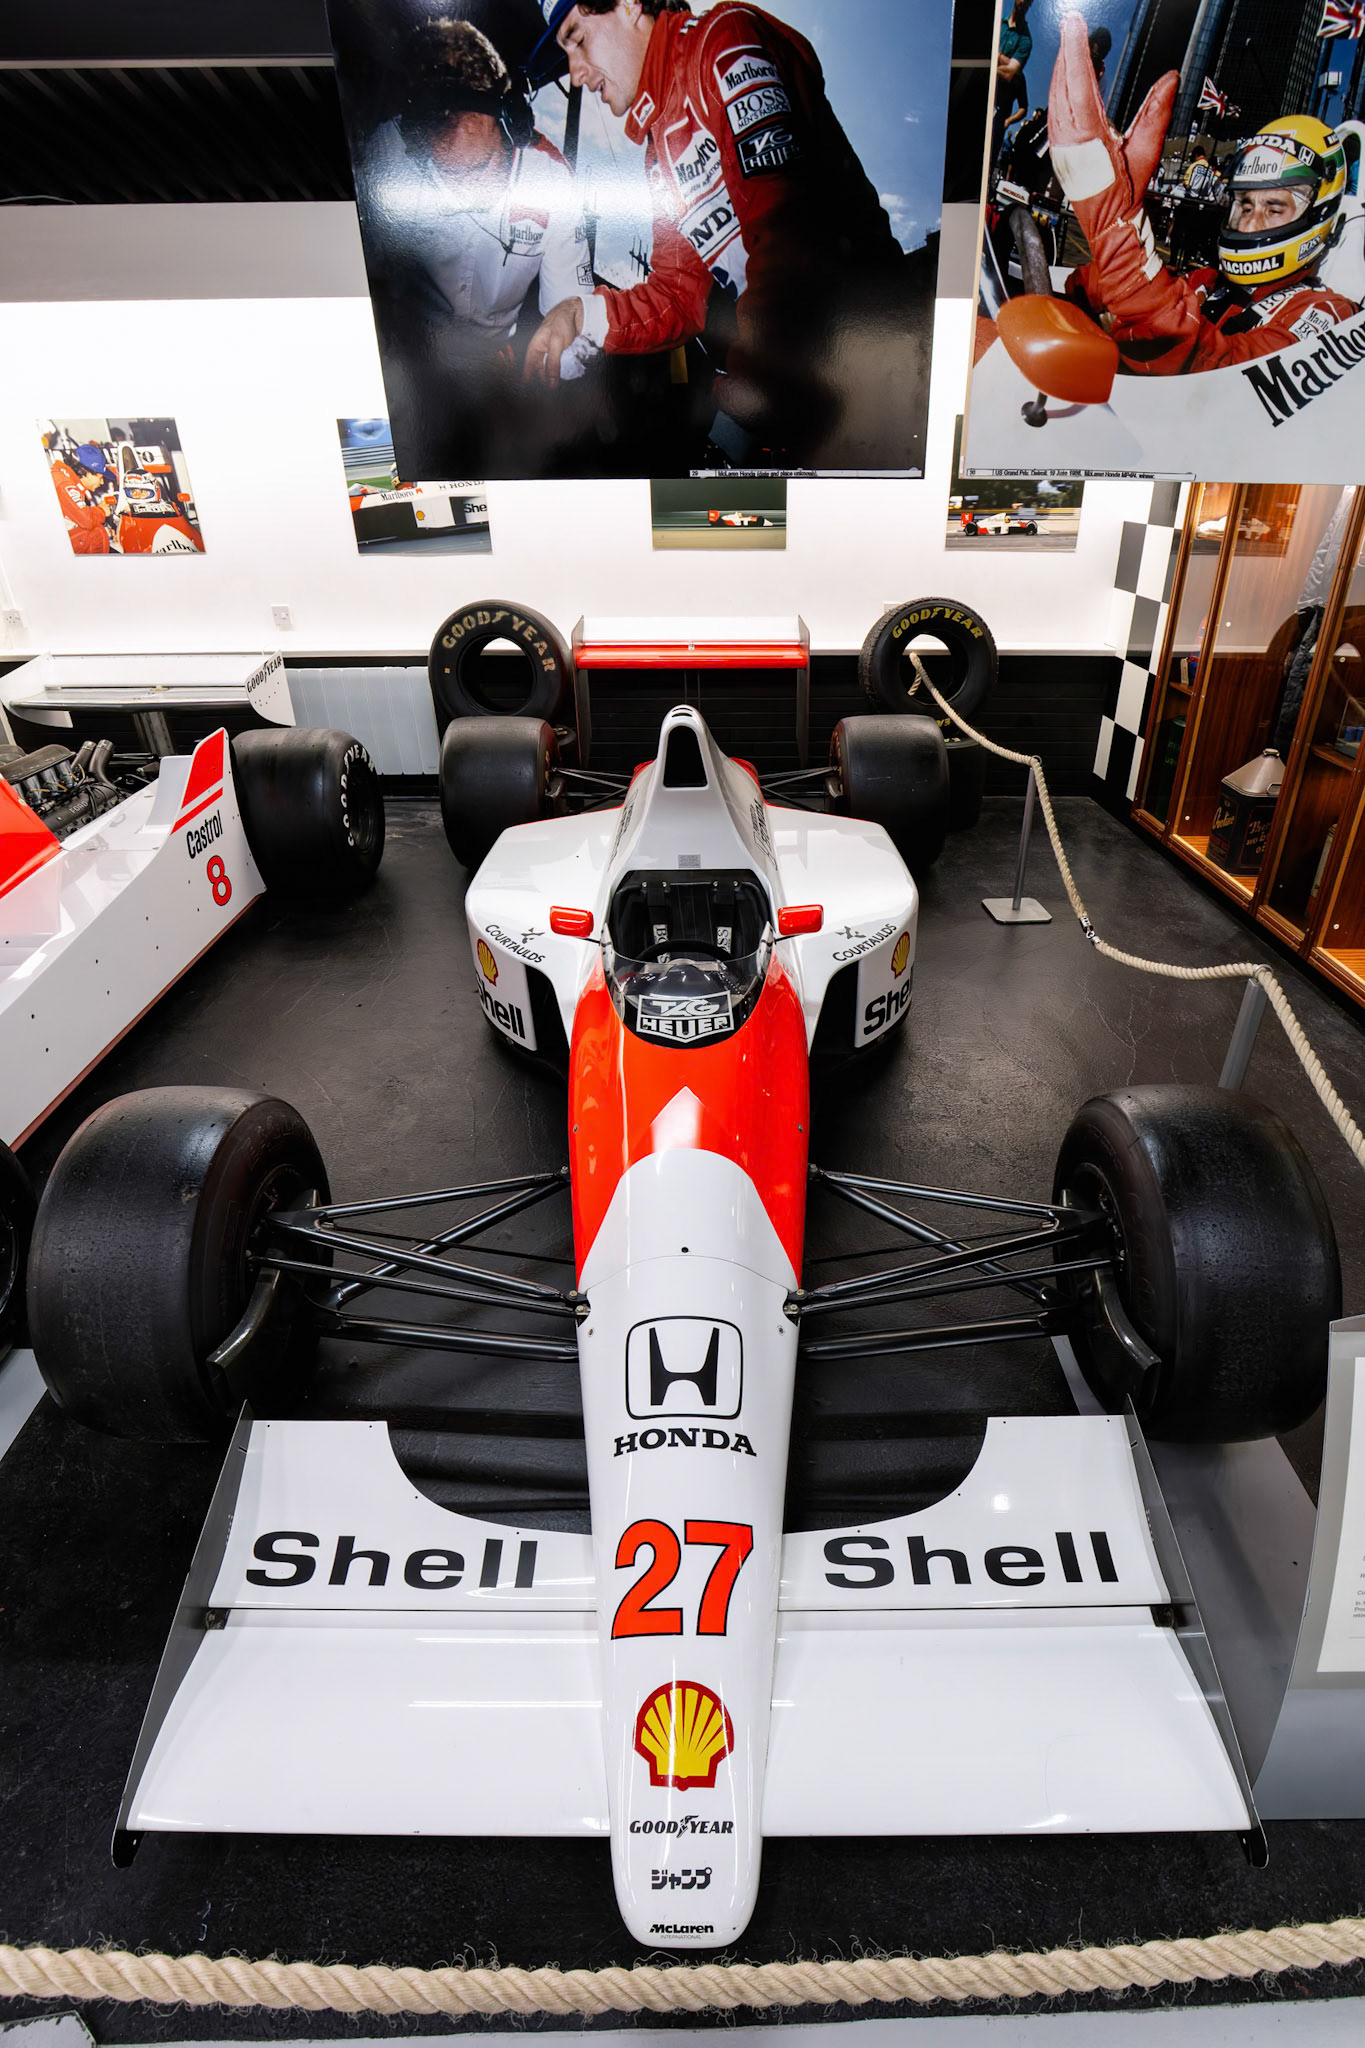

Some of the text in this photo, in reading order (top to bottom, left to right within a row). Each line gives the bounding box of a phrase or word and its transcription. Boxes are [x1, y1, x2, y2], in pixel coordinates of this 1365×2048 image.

[733, 86, 786, 121] BOSS
[687, 199, 737, 248] ND
[1241, 320, 1365, 428] Marlbo
[442, 611, 556, 672] GOODYEAR
[892, 607, 984, 639] GOODYEAR
[247, 656, 282, 693] GOODYEAR
[69, 801, 88, 814] FORD
[186, 809, 223, 859] Castrol
[207, 855, 232, 906] 8
[485, 924, 546, 963] COURTAULDS
[832, 924, 897, 962] COURTAULDS
[650, 999, 721, 1017] TAG
[642, 1016, 729, 1039] HEUER
[614, 1428, 757, 1457] HONDA
[246, 1531, 538, 1590] Shell
[824, 1531, 1120, 1589] Shell
[611, 1518, 754, 1640] 27
[629, 1818, 734, 1836] GOODYEAR
[652, 1867, 712, 1889] ジャンプ
[649, 1924, 714, 1934] McLaren
